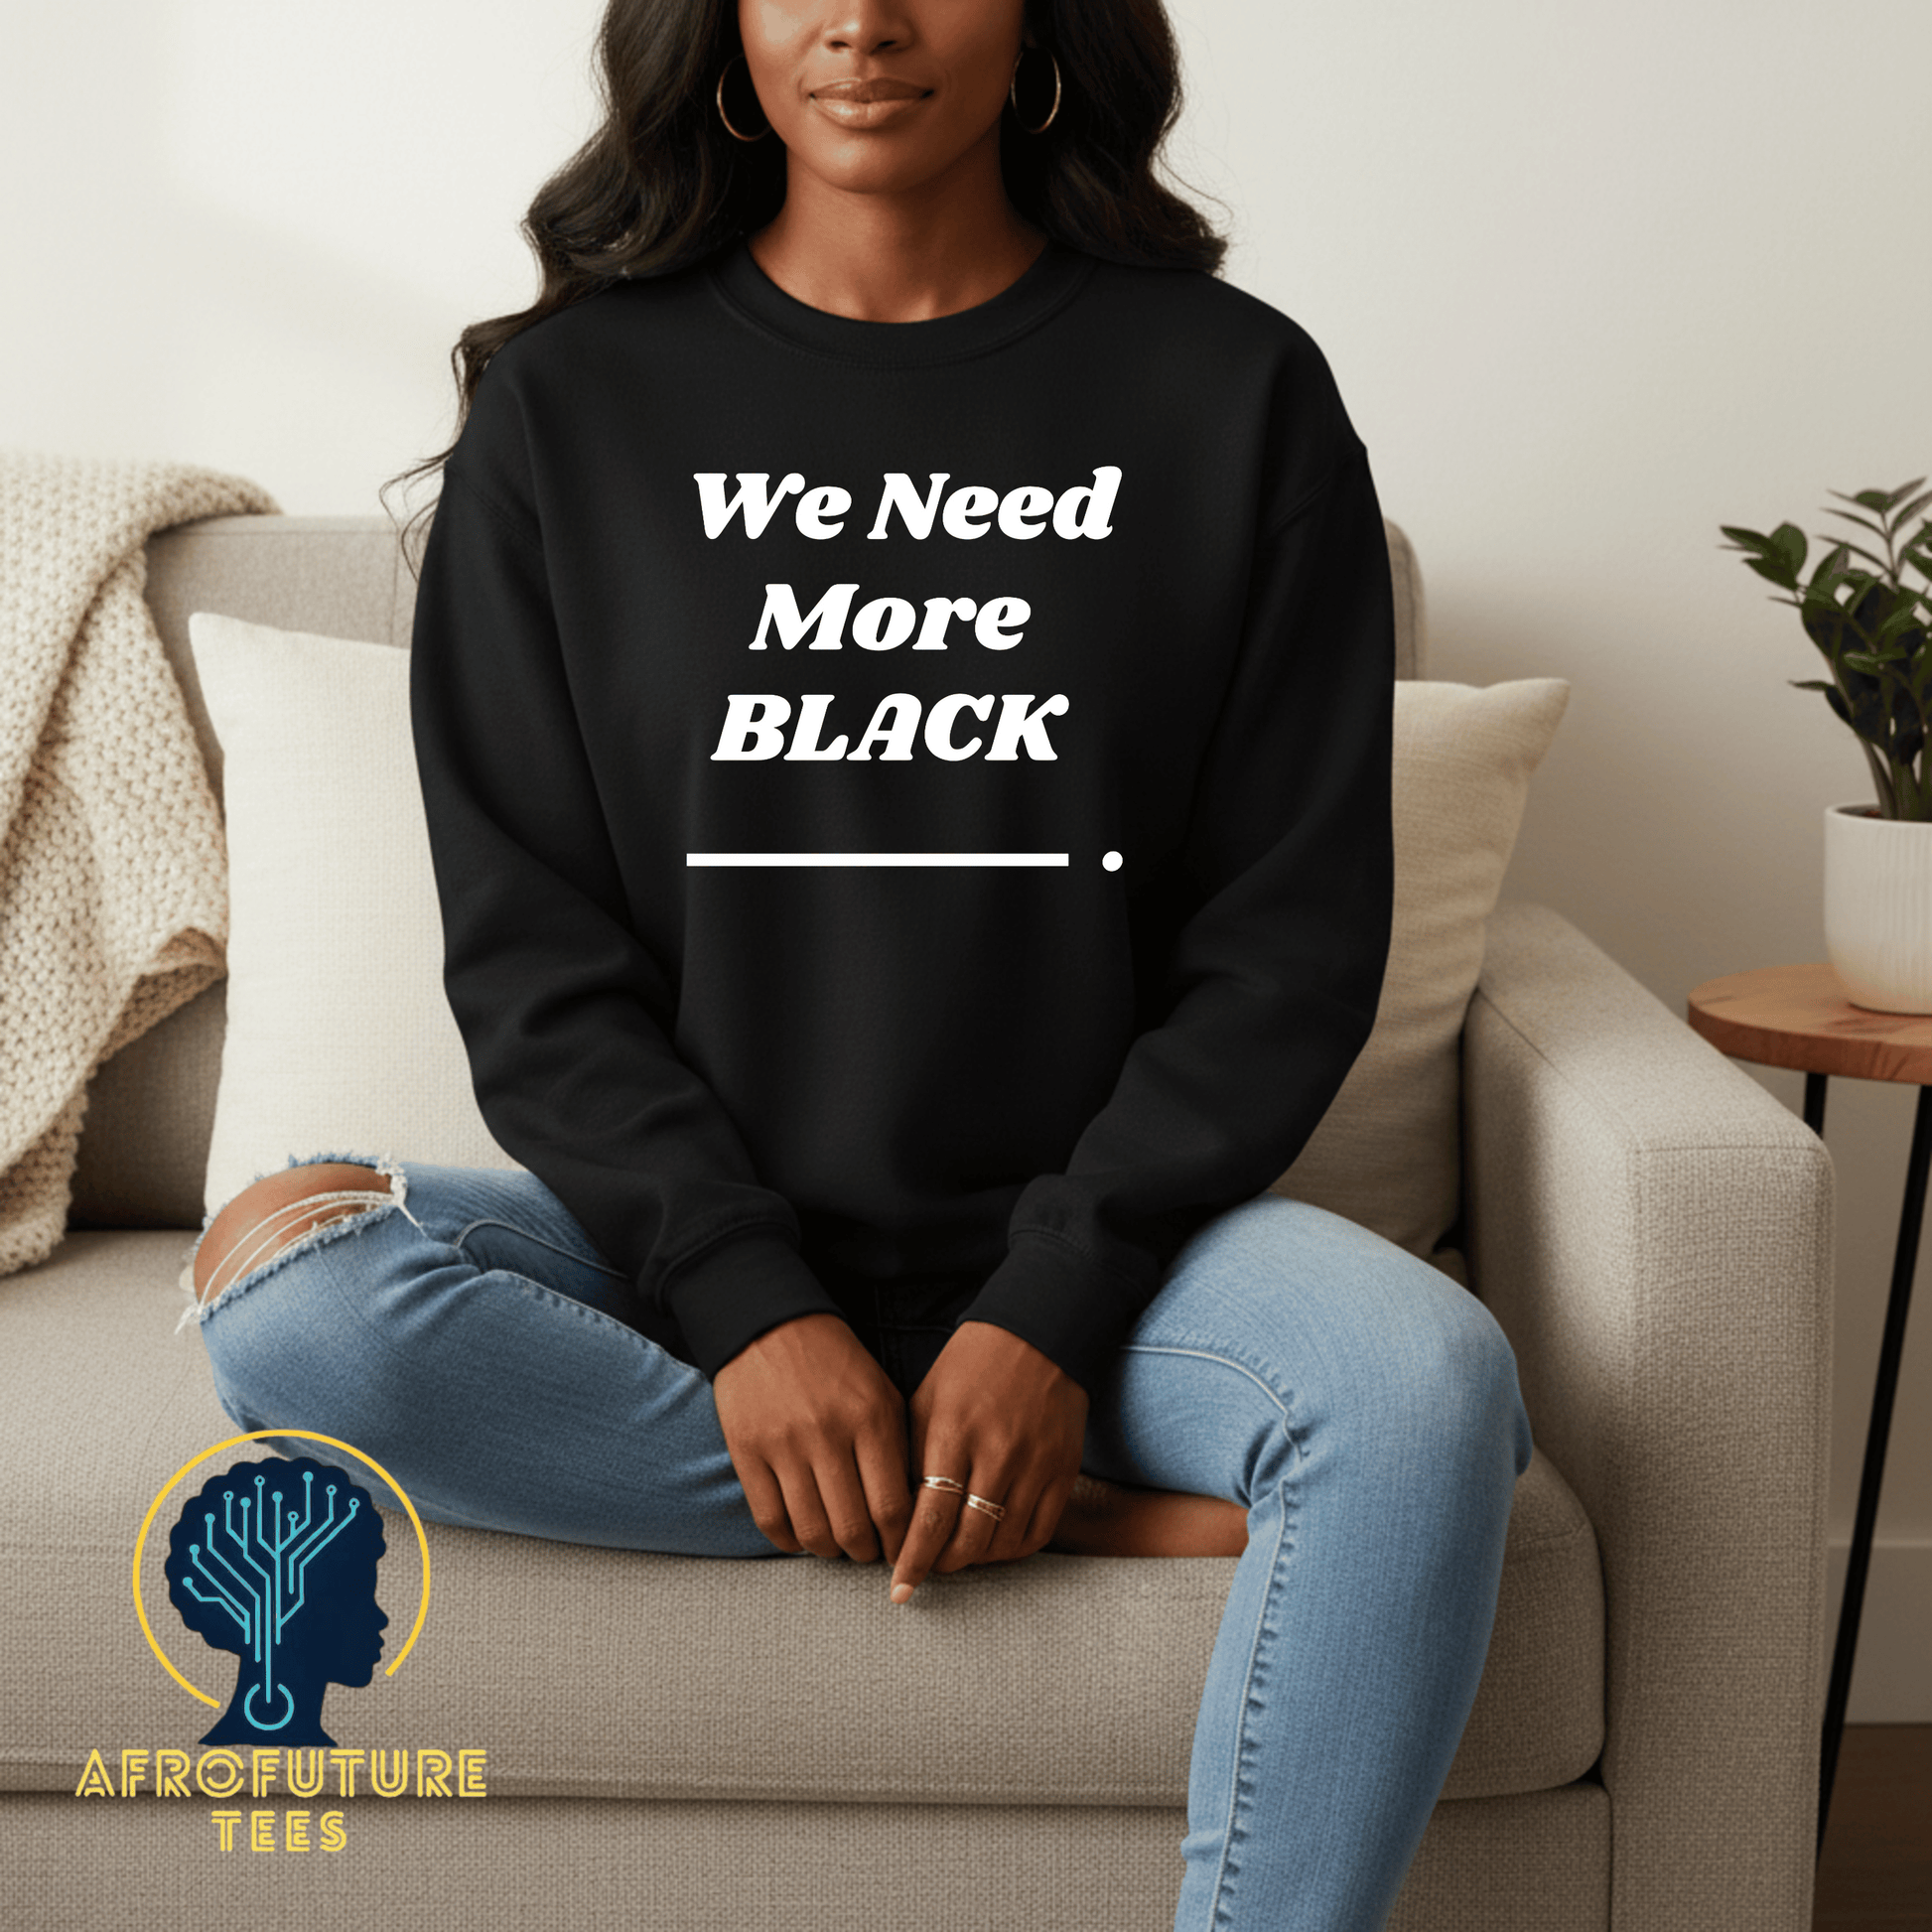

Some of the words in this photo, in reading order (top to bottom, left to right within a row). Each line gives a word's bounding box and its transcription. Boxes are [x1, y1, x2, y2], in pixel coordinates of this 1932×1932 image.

[693, 473, 853, 540] We
[866, 466, 1123, 540] Need
[748, 583, 1032, 651] More
[710, 692, 1070, 761] BLACK
